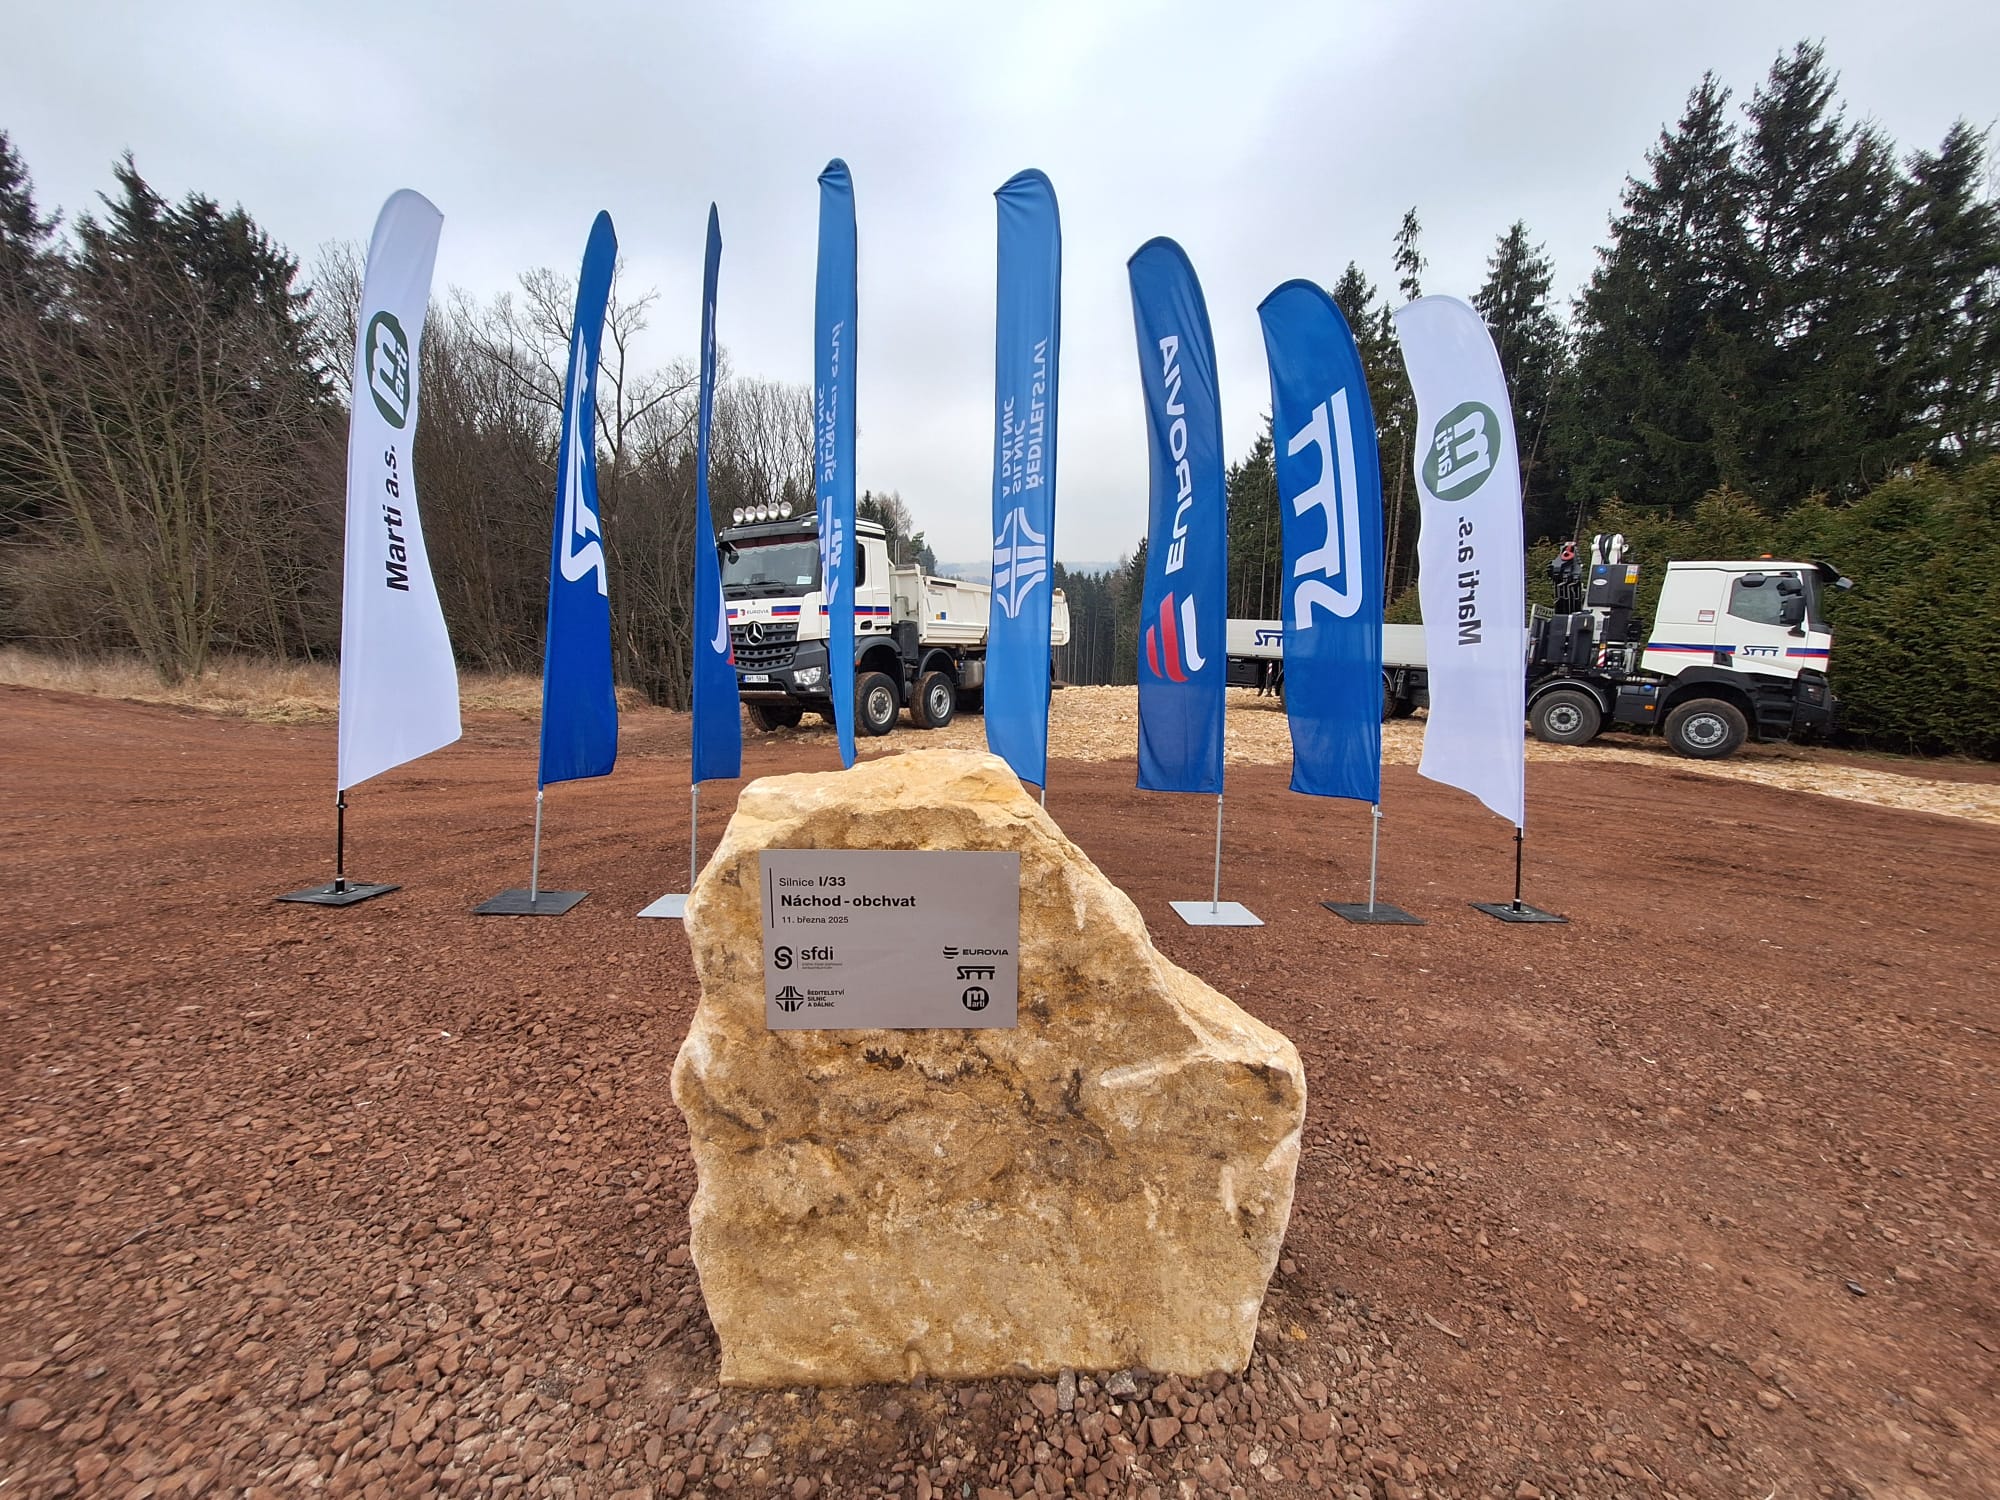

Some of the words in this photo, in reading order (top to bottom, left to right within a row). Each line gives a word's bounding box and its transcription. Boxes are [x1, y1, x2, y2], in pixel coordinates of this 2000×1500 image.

[384, 445, 399, 498] a.s.
[382, 504, 409, 591] Marti
[1742, 645, 1779, 656] STTT
[779, 877, 814, 887] Silnice
[819, 876, 846, 887] I/33
[781, 895, 841, 907] Náchod
[852, 895, 916, 907] obchvat
[797, 916, 826, 924] března
[801, 946, 833, 960] sfdi
[957, 966, 995, 980] STTT
